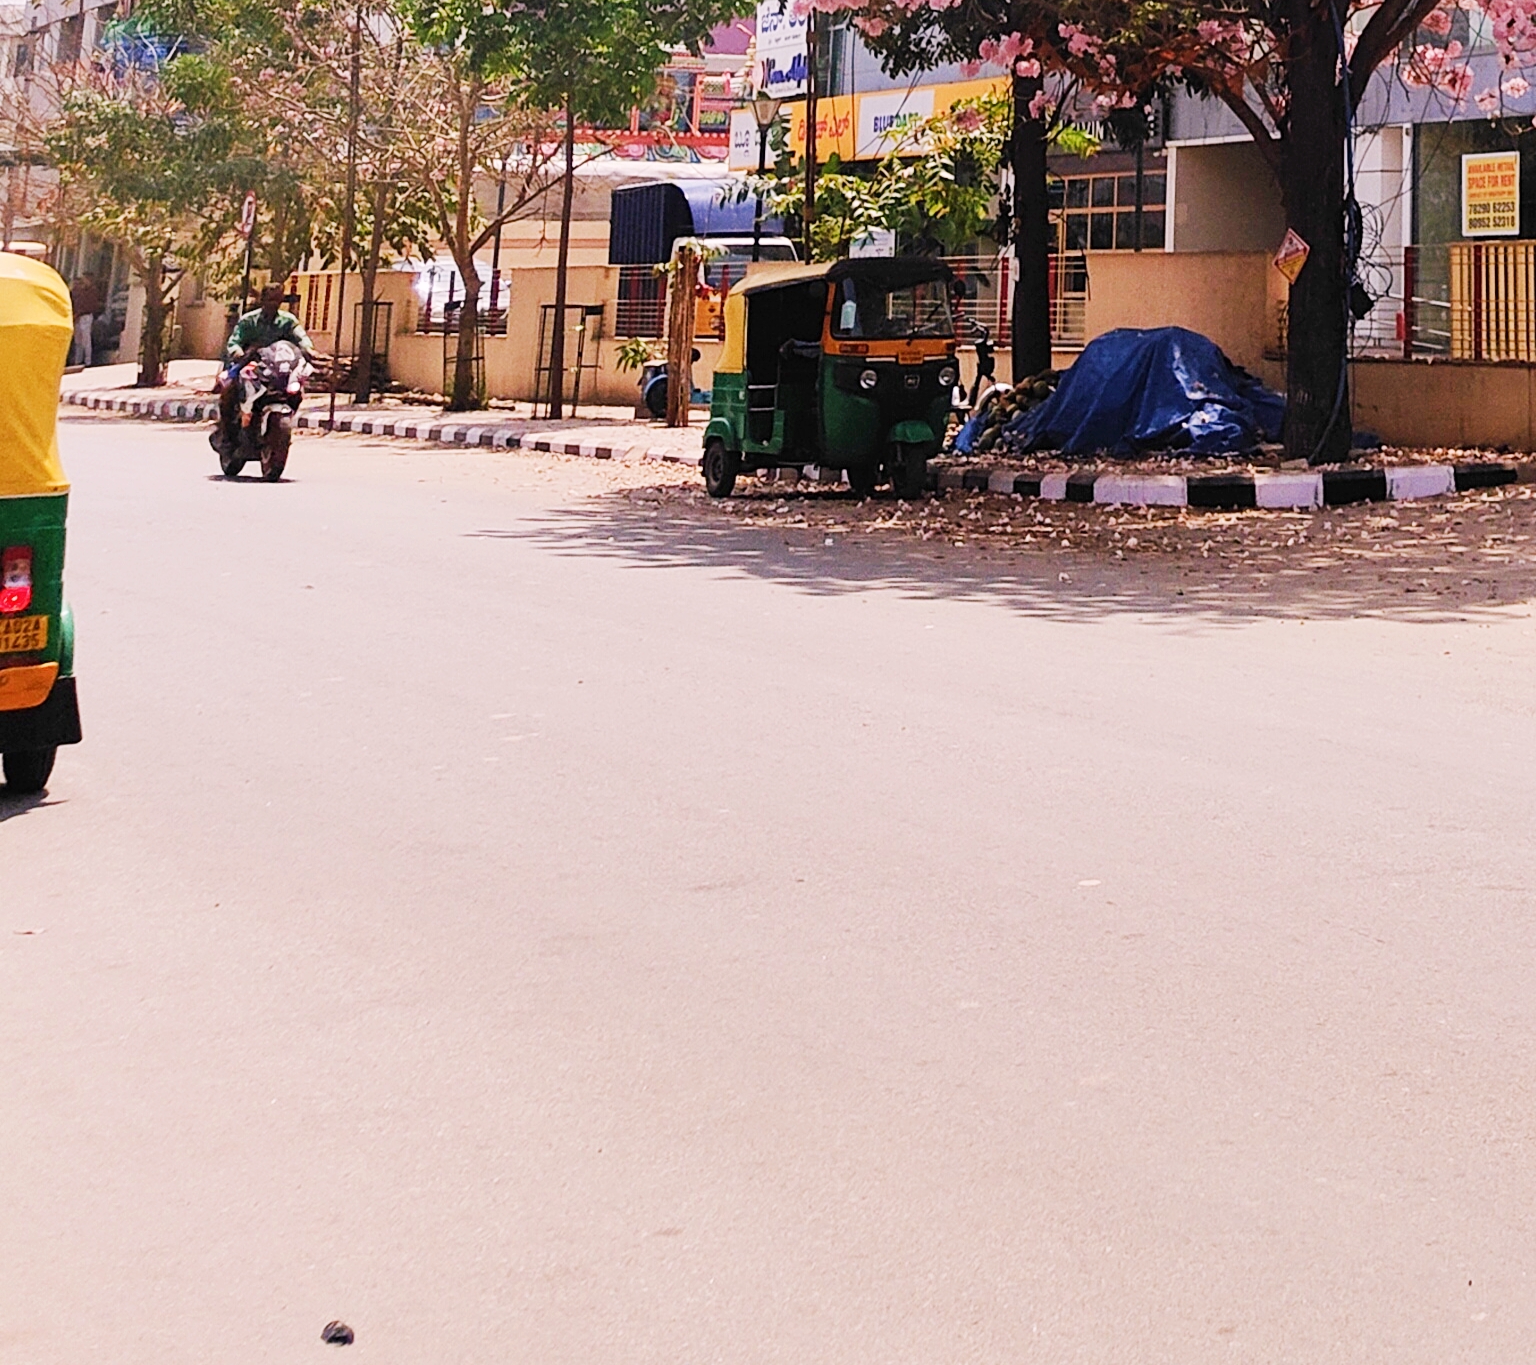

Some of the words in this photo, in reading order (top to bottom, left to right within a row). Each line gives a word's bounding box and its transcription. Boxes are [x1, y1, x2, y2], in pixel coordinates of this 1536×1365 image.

[1468, 176, 1486, 189] SPACE
[1487, 175, 1498, 188] FOR
[1500, 173, 1515, 187] RENT
